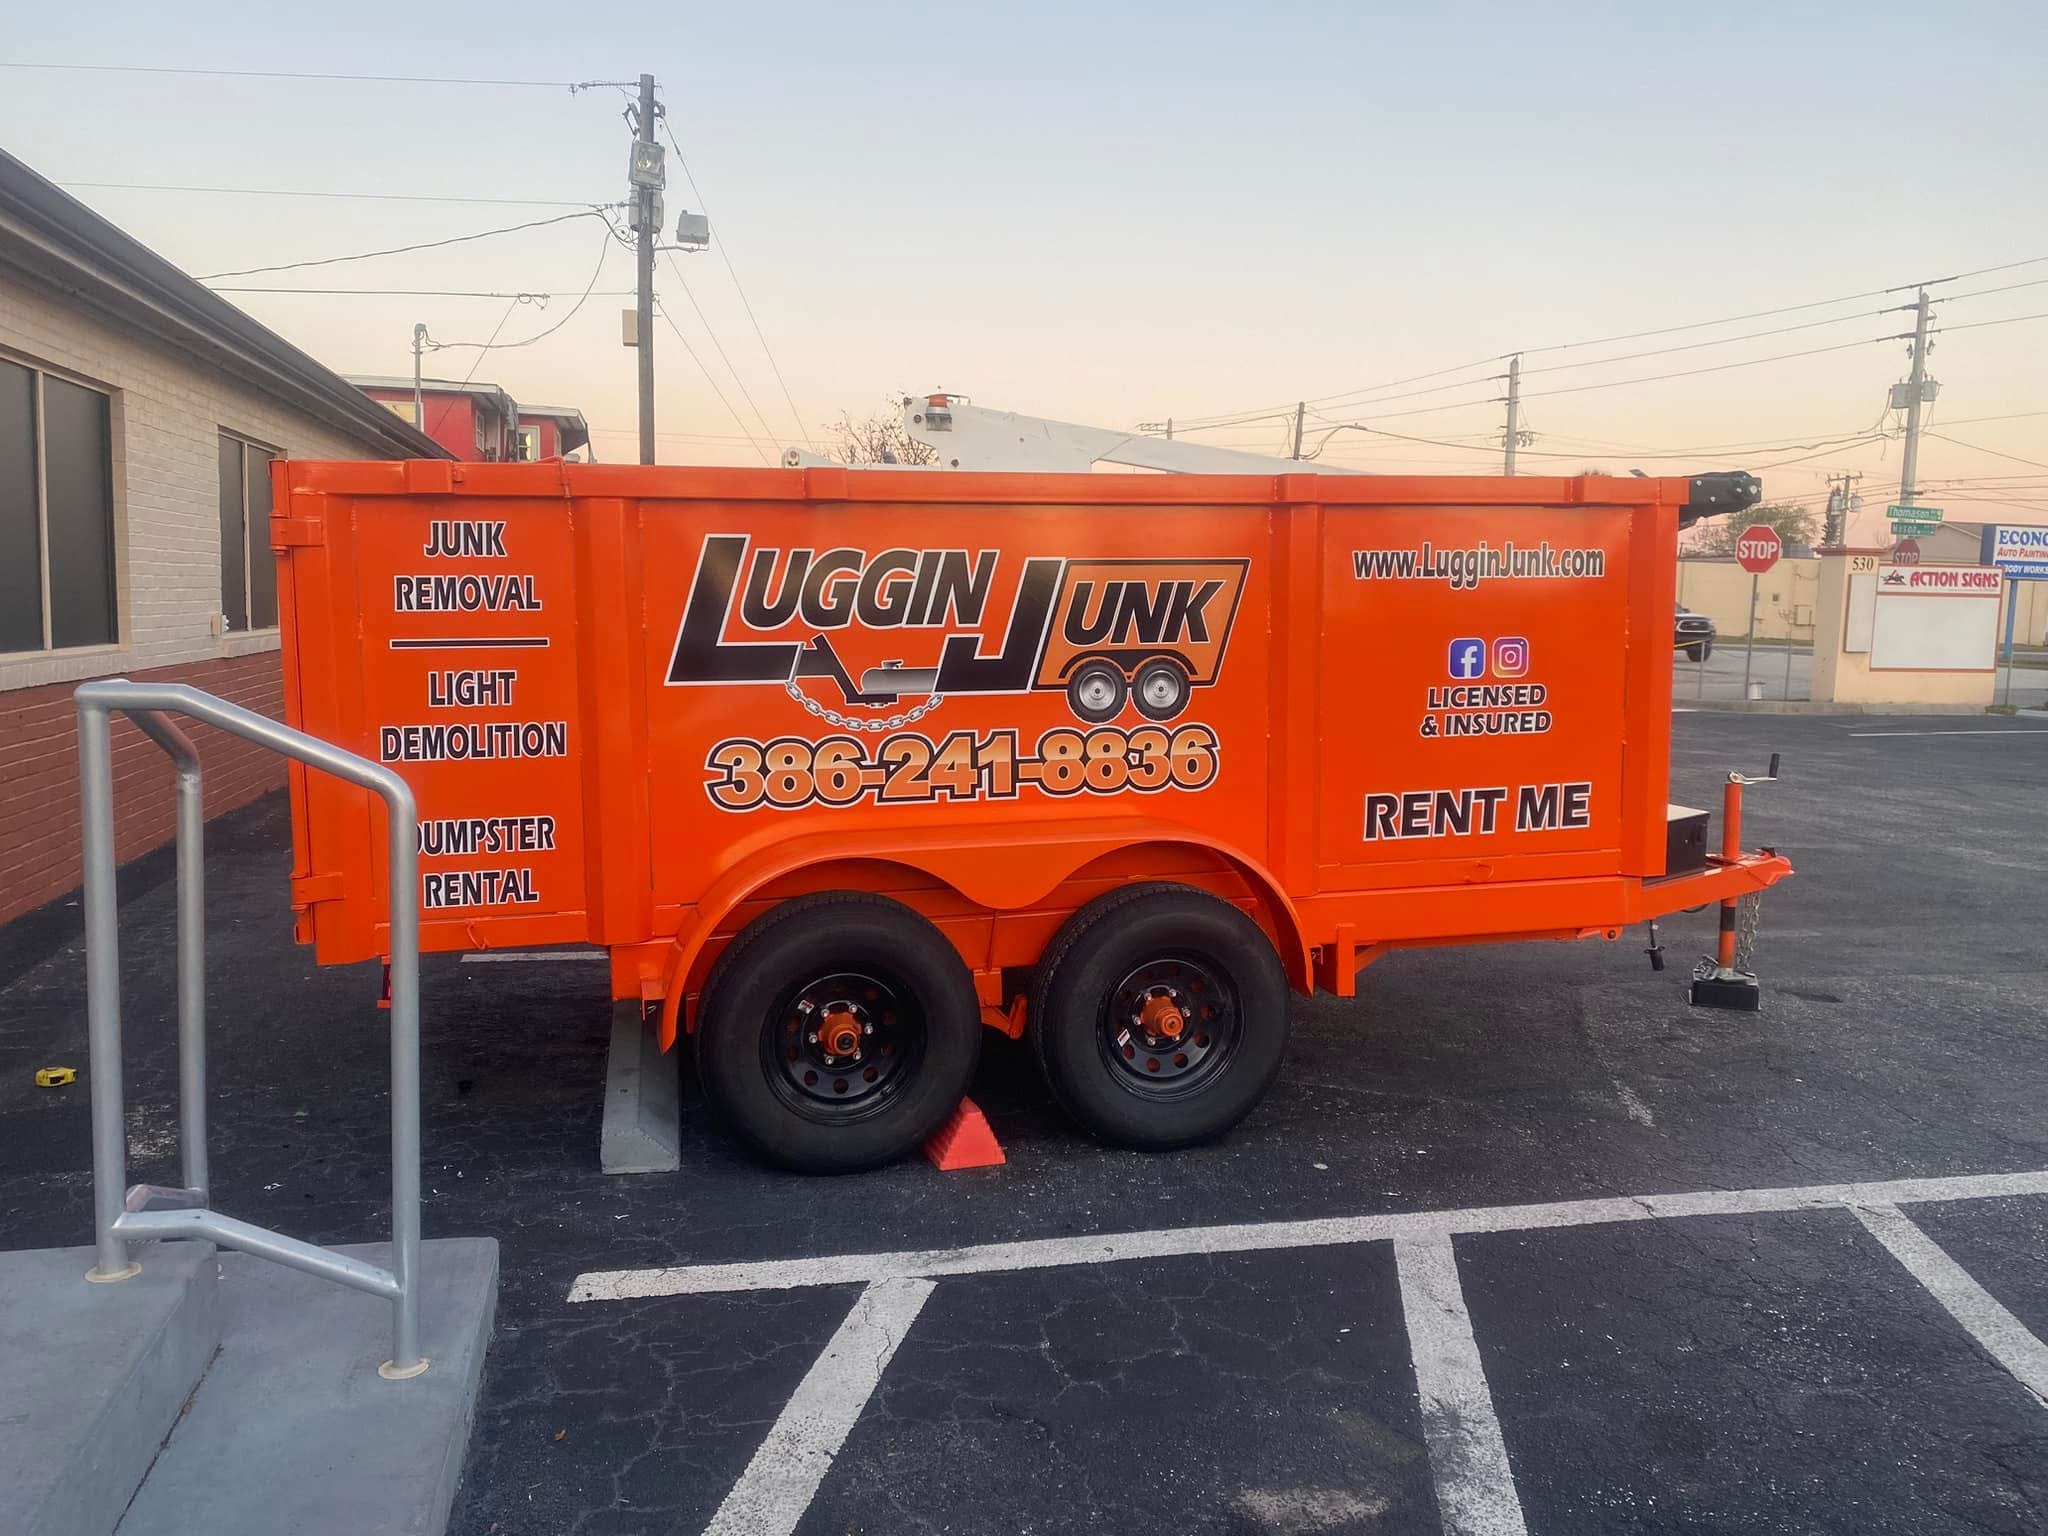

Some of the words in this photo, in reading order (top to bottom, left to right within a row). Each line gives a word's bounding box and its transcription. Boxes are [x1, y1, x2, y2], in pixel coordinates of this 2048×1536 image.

[424, 521, 507, 558] JUNK
[1738, 540, 1778, 560] STOP
[1352, 541, 1605, 590] www.LugginJunk.com
[1851, 557, 1874, 571] 530
[1910, 571, 1959, 587] ACTION
[1961, 573, 2000, 588] SIGNS
[394, 575, 542, 612] REMOVAL
[664, 533, 1001, 686] LUGGIN
[932, 557, 1228, 694] JUNK
[428, 670, 517, 708] LIGHT
[1427, 684, 1547, 710] LICENSED
[380, 722, 567, 763] DEMOLITION
[1420, 715, 1438, 737] &
[1445, 711, 1552, 737] INSURED
[703, 723, 1222, 814] 386-241-8836
[1363, 787, 1508, 841] RENT
[1515, 782, 1592, 832] ME
[424, 869, 540, 908] RENTAL
